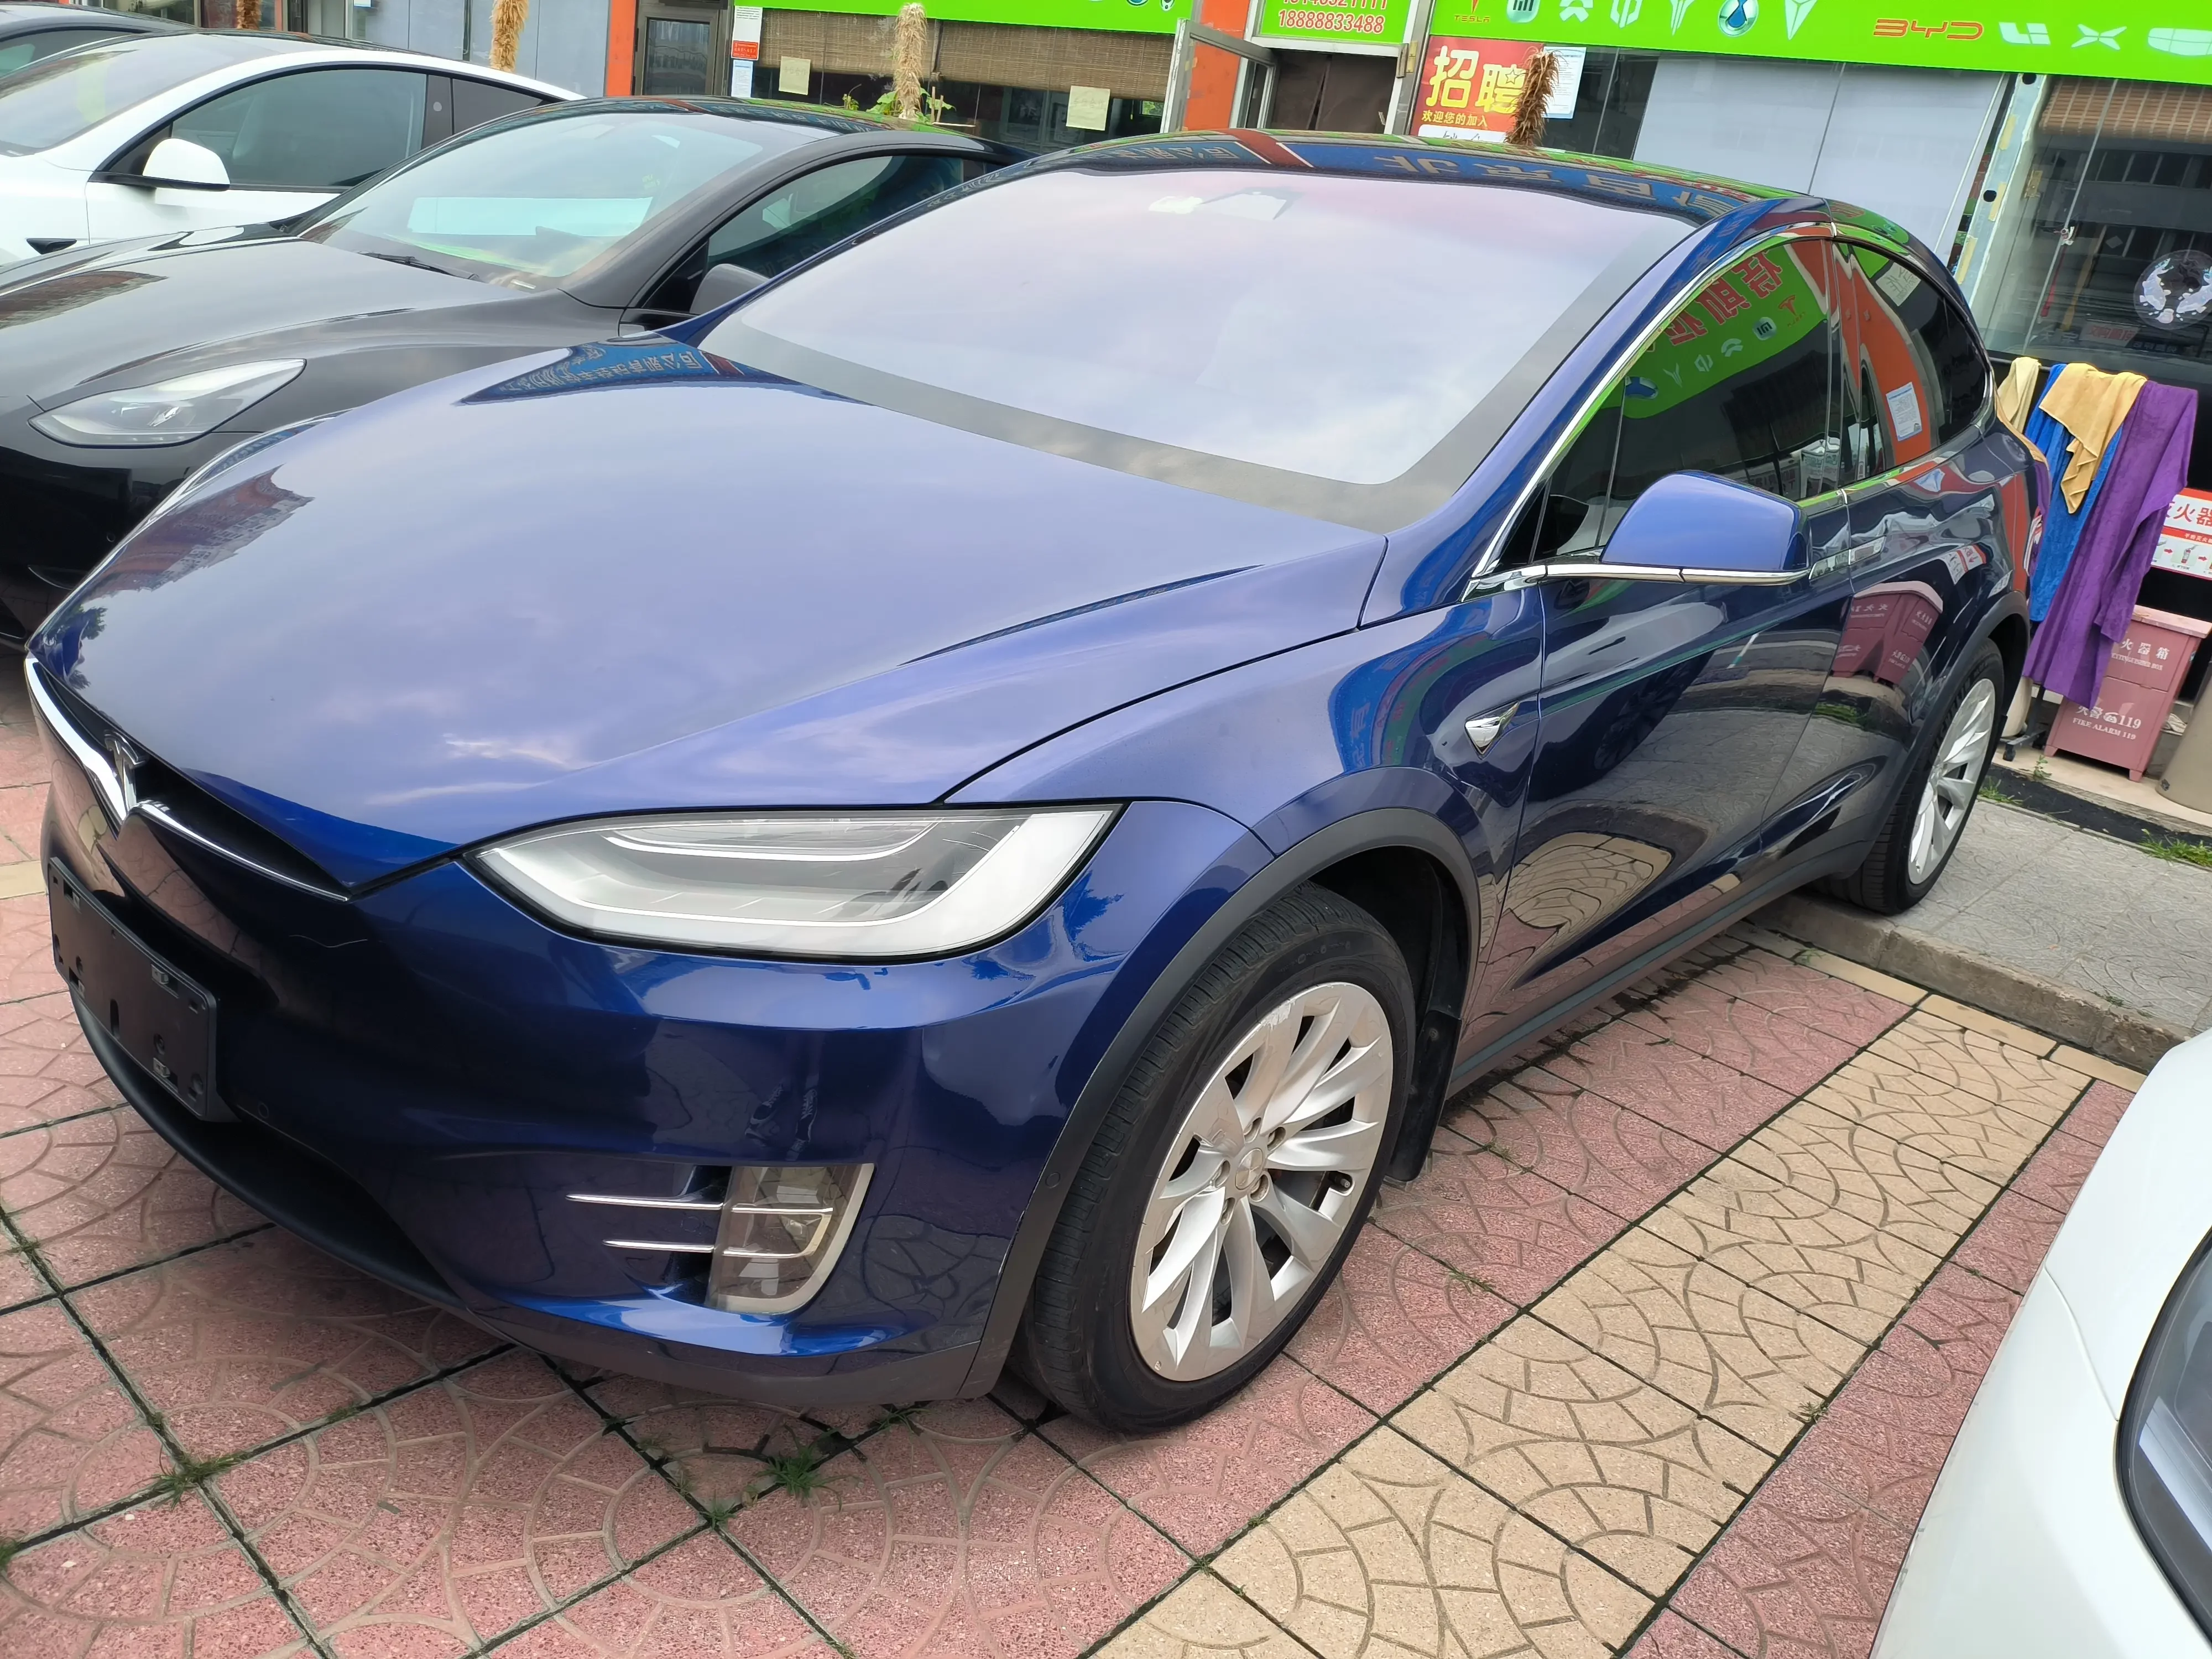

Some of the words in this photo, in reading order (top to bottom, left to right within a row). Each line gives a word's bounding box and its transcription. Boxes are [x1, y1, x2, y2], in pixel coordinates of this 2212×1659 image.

[1279, 10, 1385, 34] 18888833488
[1873, 18, 1984, 40] BYD
[1426, 45, 1527, 114] 招聘
[1422, 109, 1488, 128] 欢迎您的加入
[2092, 724, 2122, 736] ALARM
[2122, 732, 2137, 740] 119
[2117, 715, 2141, 729] 119
